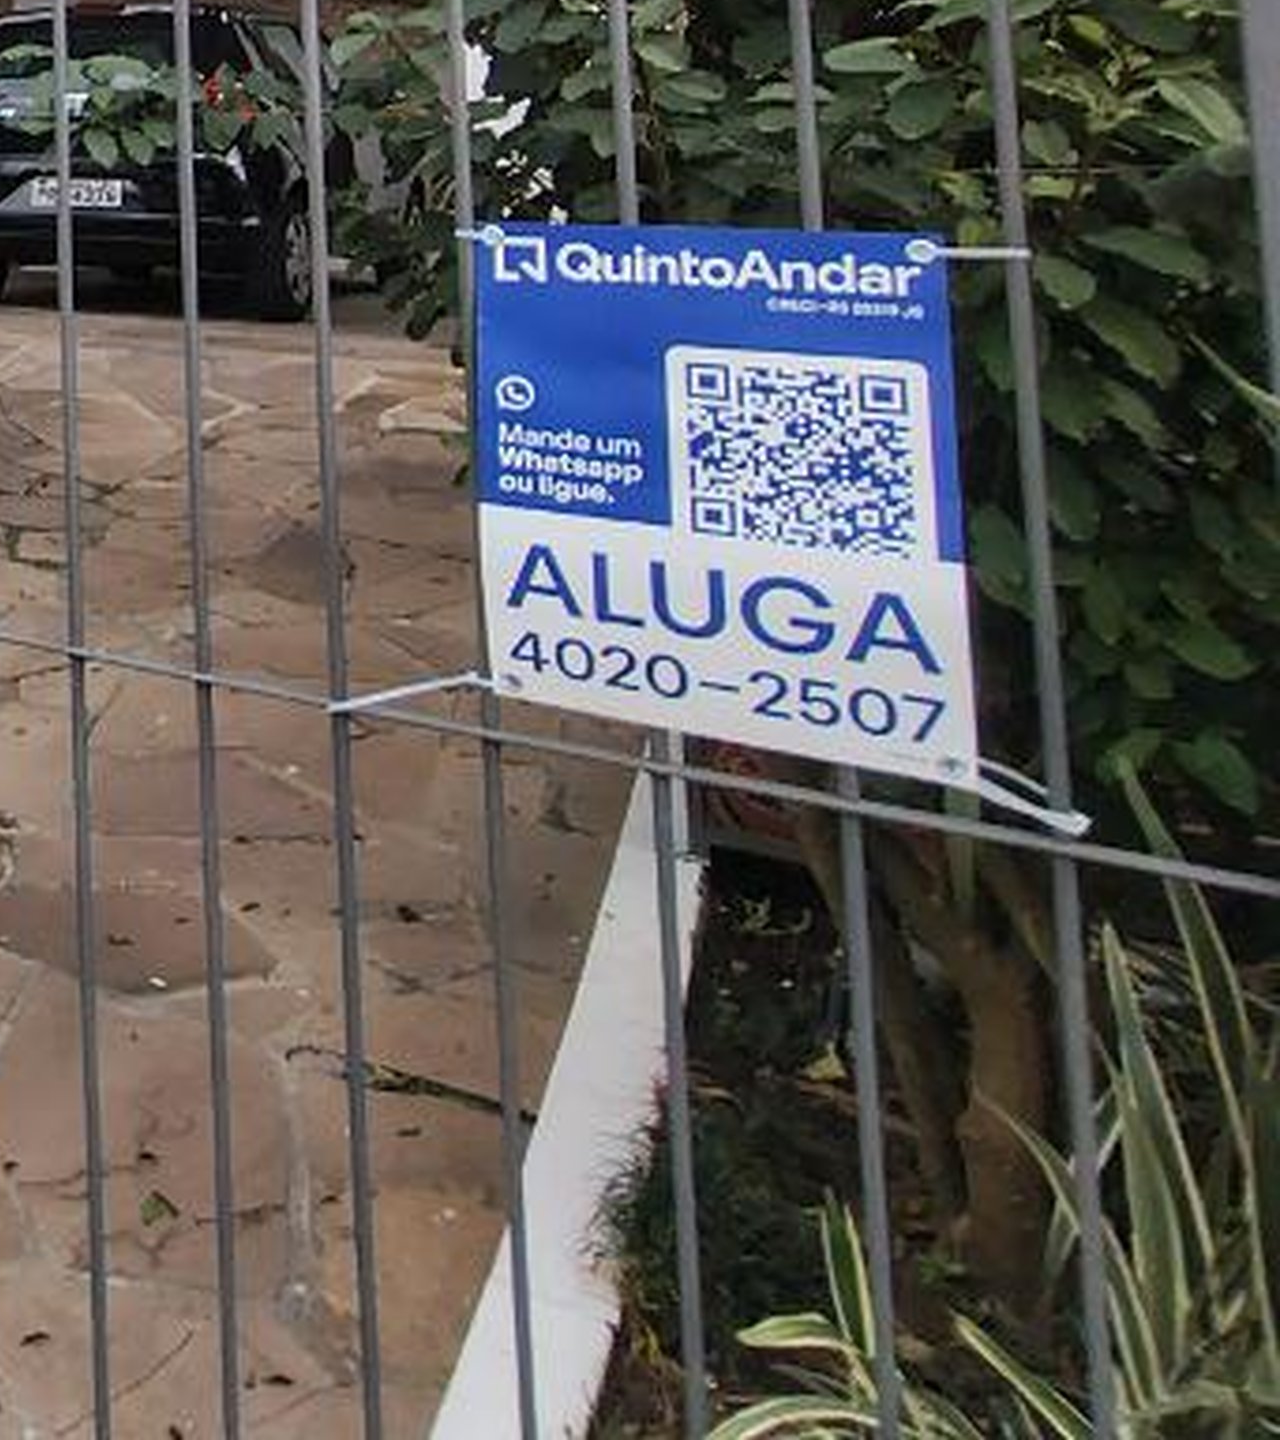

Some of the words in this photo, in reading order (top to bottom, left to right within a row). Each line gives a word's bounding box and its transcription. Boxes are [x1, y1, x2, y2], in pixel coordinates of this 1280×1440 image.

[555, 241, 922, 298] QuintoAndar
[498, 421, 591, 453] Mande
[595, 436, 642, 458] um
[498, 445, 644, 487] Whatsapp
[498, 473, 534, 493] ou
[538, 473, 616, 504] ligue.
[505, 542, 944, 675] ALUGA
[508, 631, 947, 743] 4020-2507
